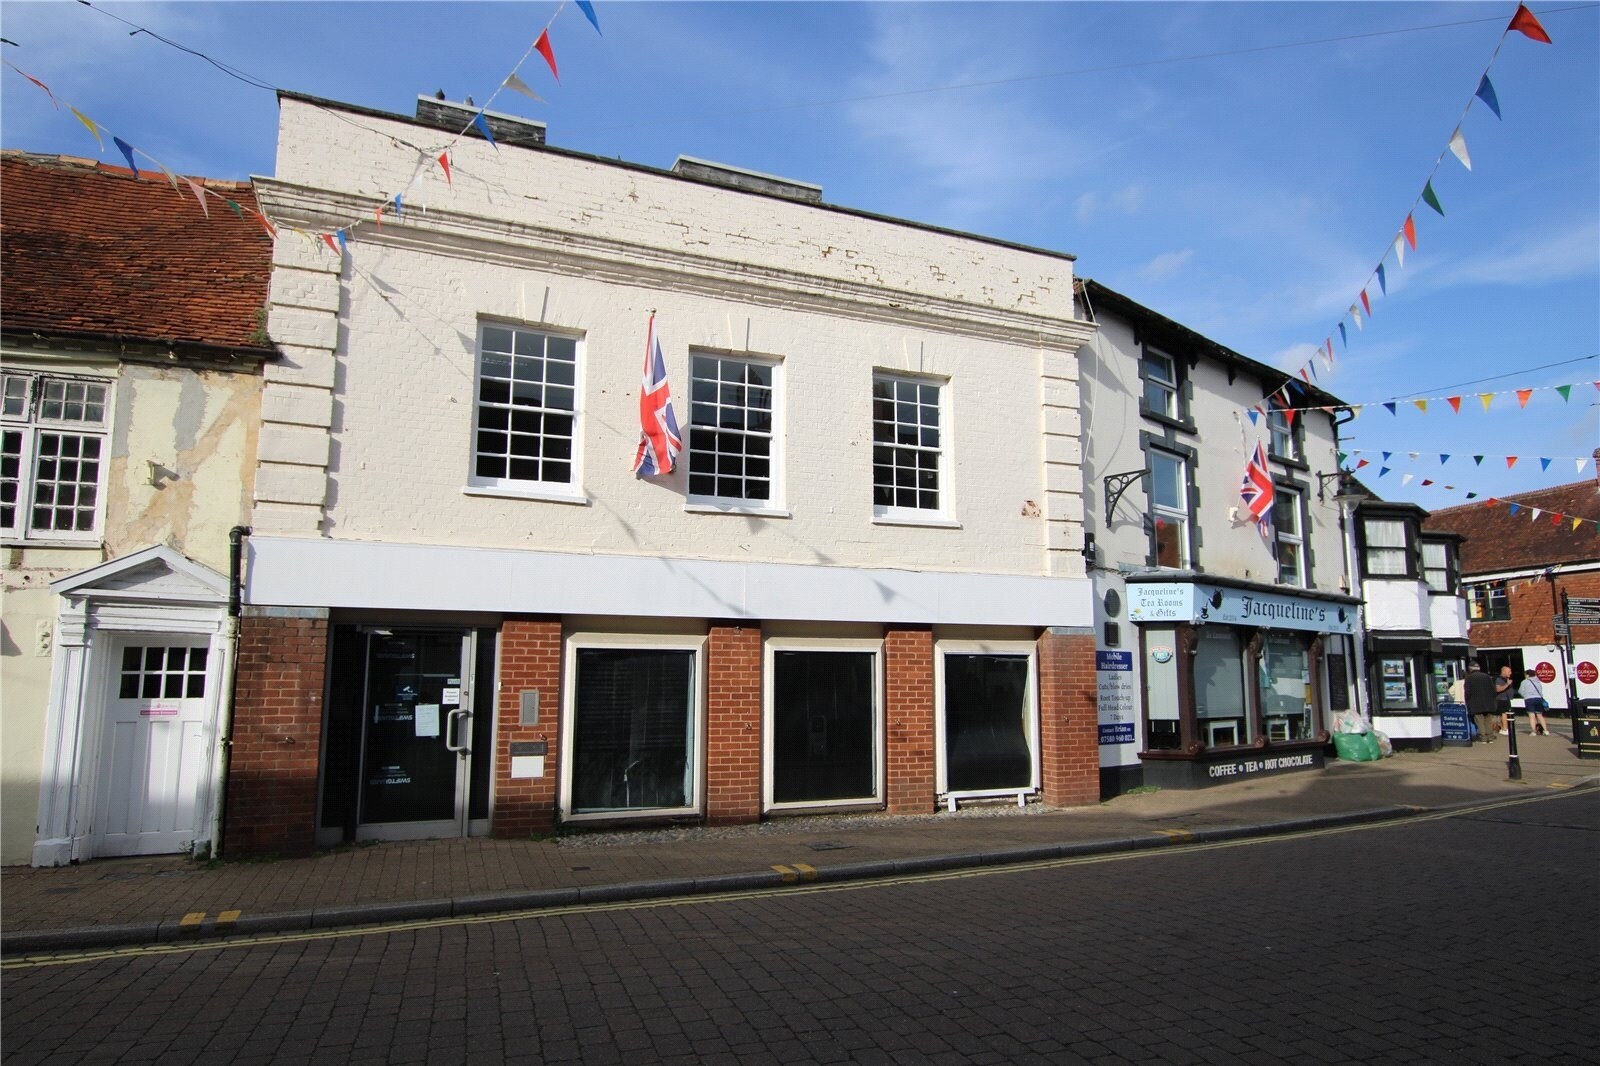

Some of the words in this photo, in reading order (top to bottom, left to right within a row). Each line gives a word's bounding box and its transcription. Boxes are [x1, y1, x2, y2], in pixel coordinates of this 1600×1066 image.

[1137, 587, 1184, 597] Jacqueline's
[1140, 598, 1155, 607] Tea
[1156, 598, 1183, 607] Rooms
[1156, 608, 1177, 617] Gifts
[1241, 595, 1326, 622] Jacqueline's
[1106, 652, 1122, 661] Mobile
[1100, 661, 1128, 670] Hairdresser
[1209, 763, 1237, 777] COFFEE
[1244, 761, 1259, 773] TEA
[1264, 758, 1278, 770] HOT
[1278, 754, 1313, 768] CHOCOLATE
